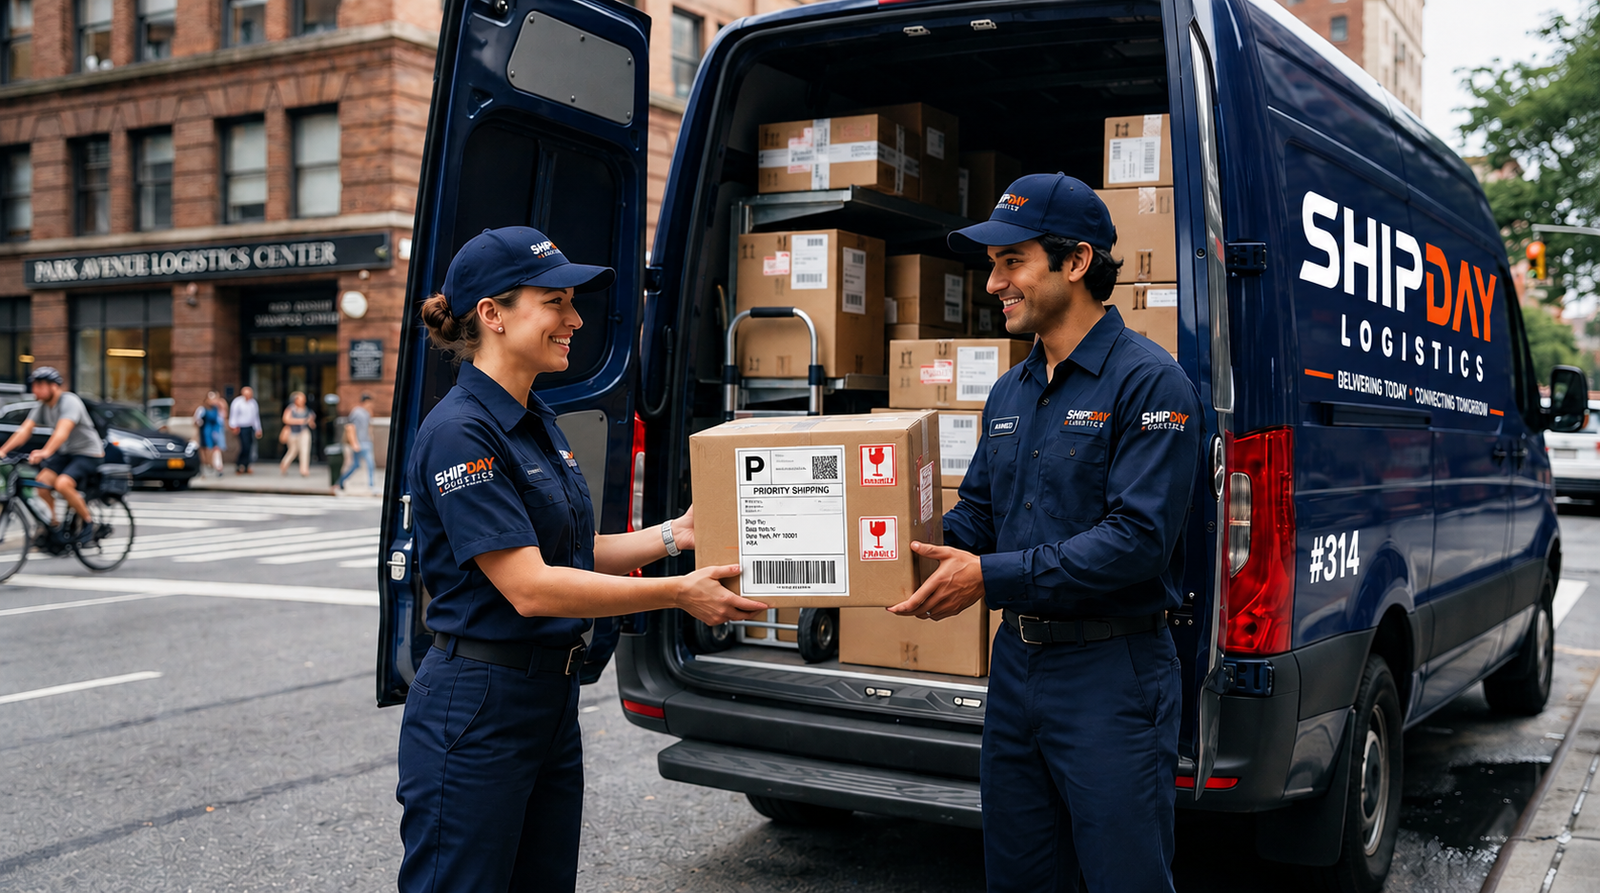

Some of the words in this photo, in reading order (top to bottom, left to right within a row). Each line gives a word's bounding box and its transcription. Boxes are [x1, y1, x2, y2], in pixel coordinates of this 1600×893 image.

[34, 258, 79, 283] PARK
[79, 253, 150, 280] AVENUE
[151, 246, 251, 275] LOGISTICS
[253, 241, 338, 269] CENTER
[1299, 190, 1498, 343] SHIPDAY
[1341, 314, 1484, 383] LOGISTICS
[1384, 379, 1408, 401] TODAY
[434, 456, 495, 487] SHIPDAY
[745, 456, 765, 481] P
[753, 487, 790, 495] PRIORITY
[792, 486, 830, 495] SHIPPING
[1310, 530, 1360, 584] #314
